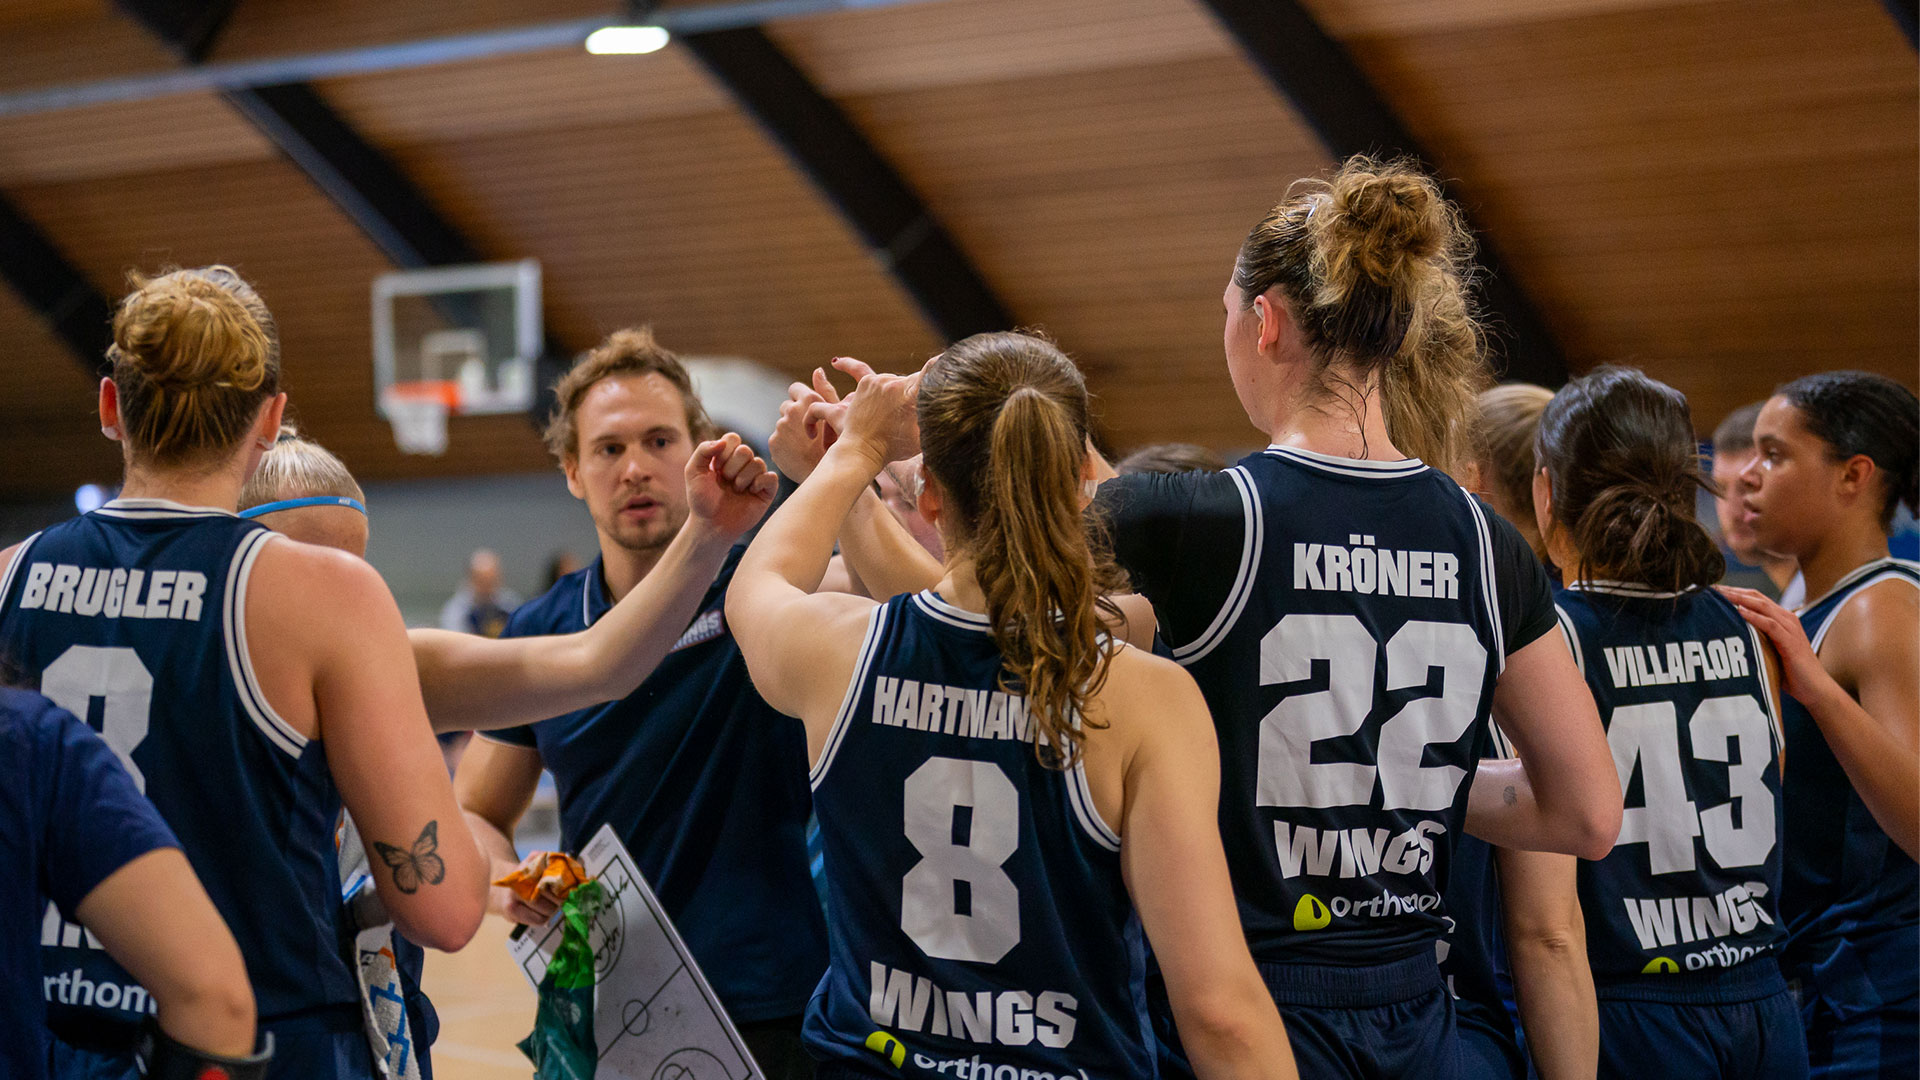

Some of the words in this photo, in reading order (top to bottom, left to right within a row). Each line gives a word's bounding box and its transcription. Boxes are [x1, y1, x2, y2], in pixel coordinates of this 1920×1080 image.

[20, 562, 208, 622] BRUGLER
[1293, 534, 1459, 600] KRÖNER
[1603, 636, 1750, 689] VILLAFLOR
[1256, 614, 1488, 811] 22
[1605, 694, 1777, 876] 43
[900, 756, 1021, 965] 8
[1273, 820, 1447, 879] WINGS
[1623, 882, 1775, 950] WINGS
[1685, 941, 1774, 971] ortho
[43, 968, 158, 1015] rthom
[870, 961, 1079, 1049] WINGS
